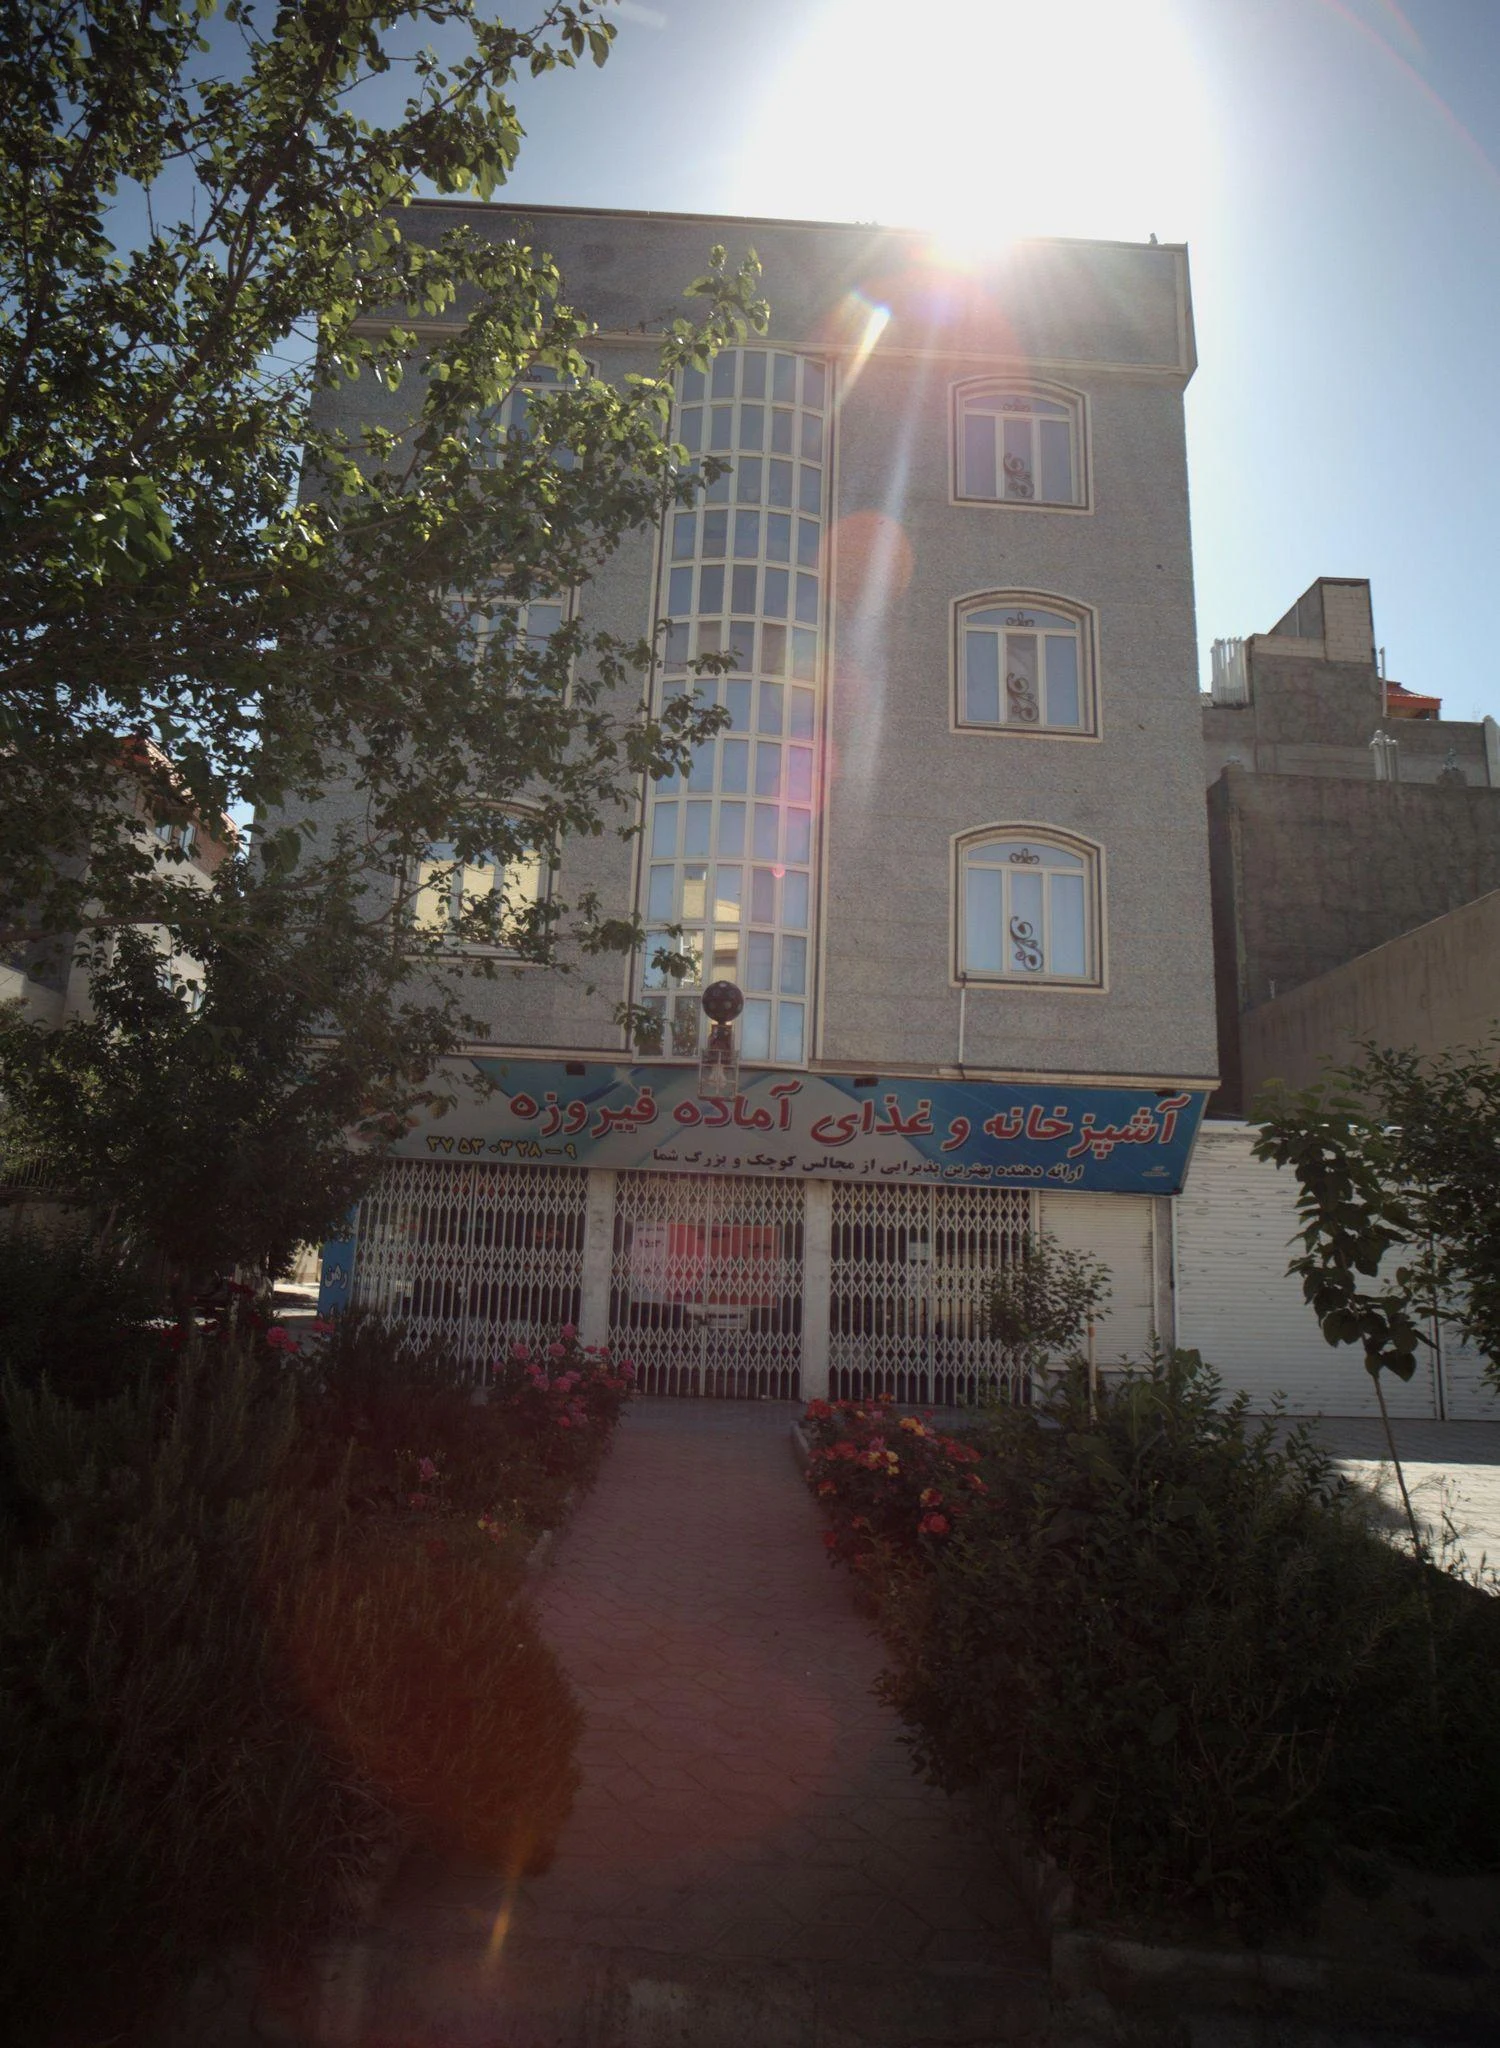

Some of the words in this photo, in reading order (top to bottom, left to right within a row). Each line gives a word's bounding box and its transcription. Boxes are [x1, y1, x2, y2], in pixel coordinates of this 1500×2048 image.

[509, 1086, 660, 1137] فیروزه
[672, 1079, 802, 1130] آماده
[810, 1094, 934, 1146] غذای
[983, 1092, 1191, 1160] آشپزخانه
[942, 1115, 972, 1153] و
[653, 1148, 679, 1162] شما
[684, 1150, 728, 1168] بزرگ
[732, 1157, 741, 1169] و
[747, 1153, 797, 1172] کوچک
[802, 1156, 856, 1173] مجالس
[860, 1157, 877, 1175] از
[882, 1157, 942, 1178] پذیرایی
[944, 1162, 992, 1180] بهترین
[995, 1163, 1044, 1179] دهنده
[1047, 1164, 1084, 1184] ارائه
[324, 1264, 348, 1289] رهن
